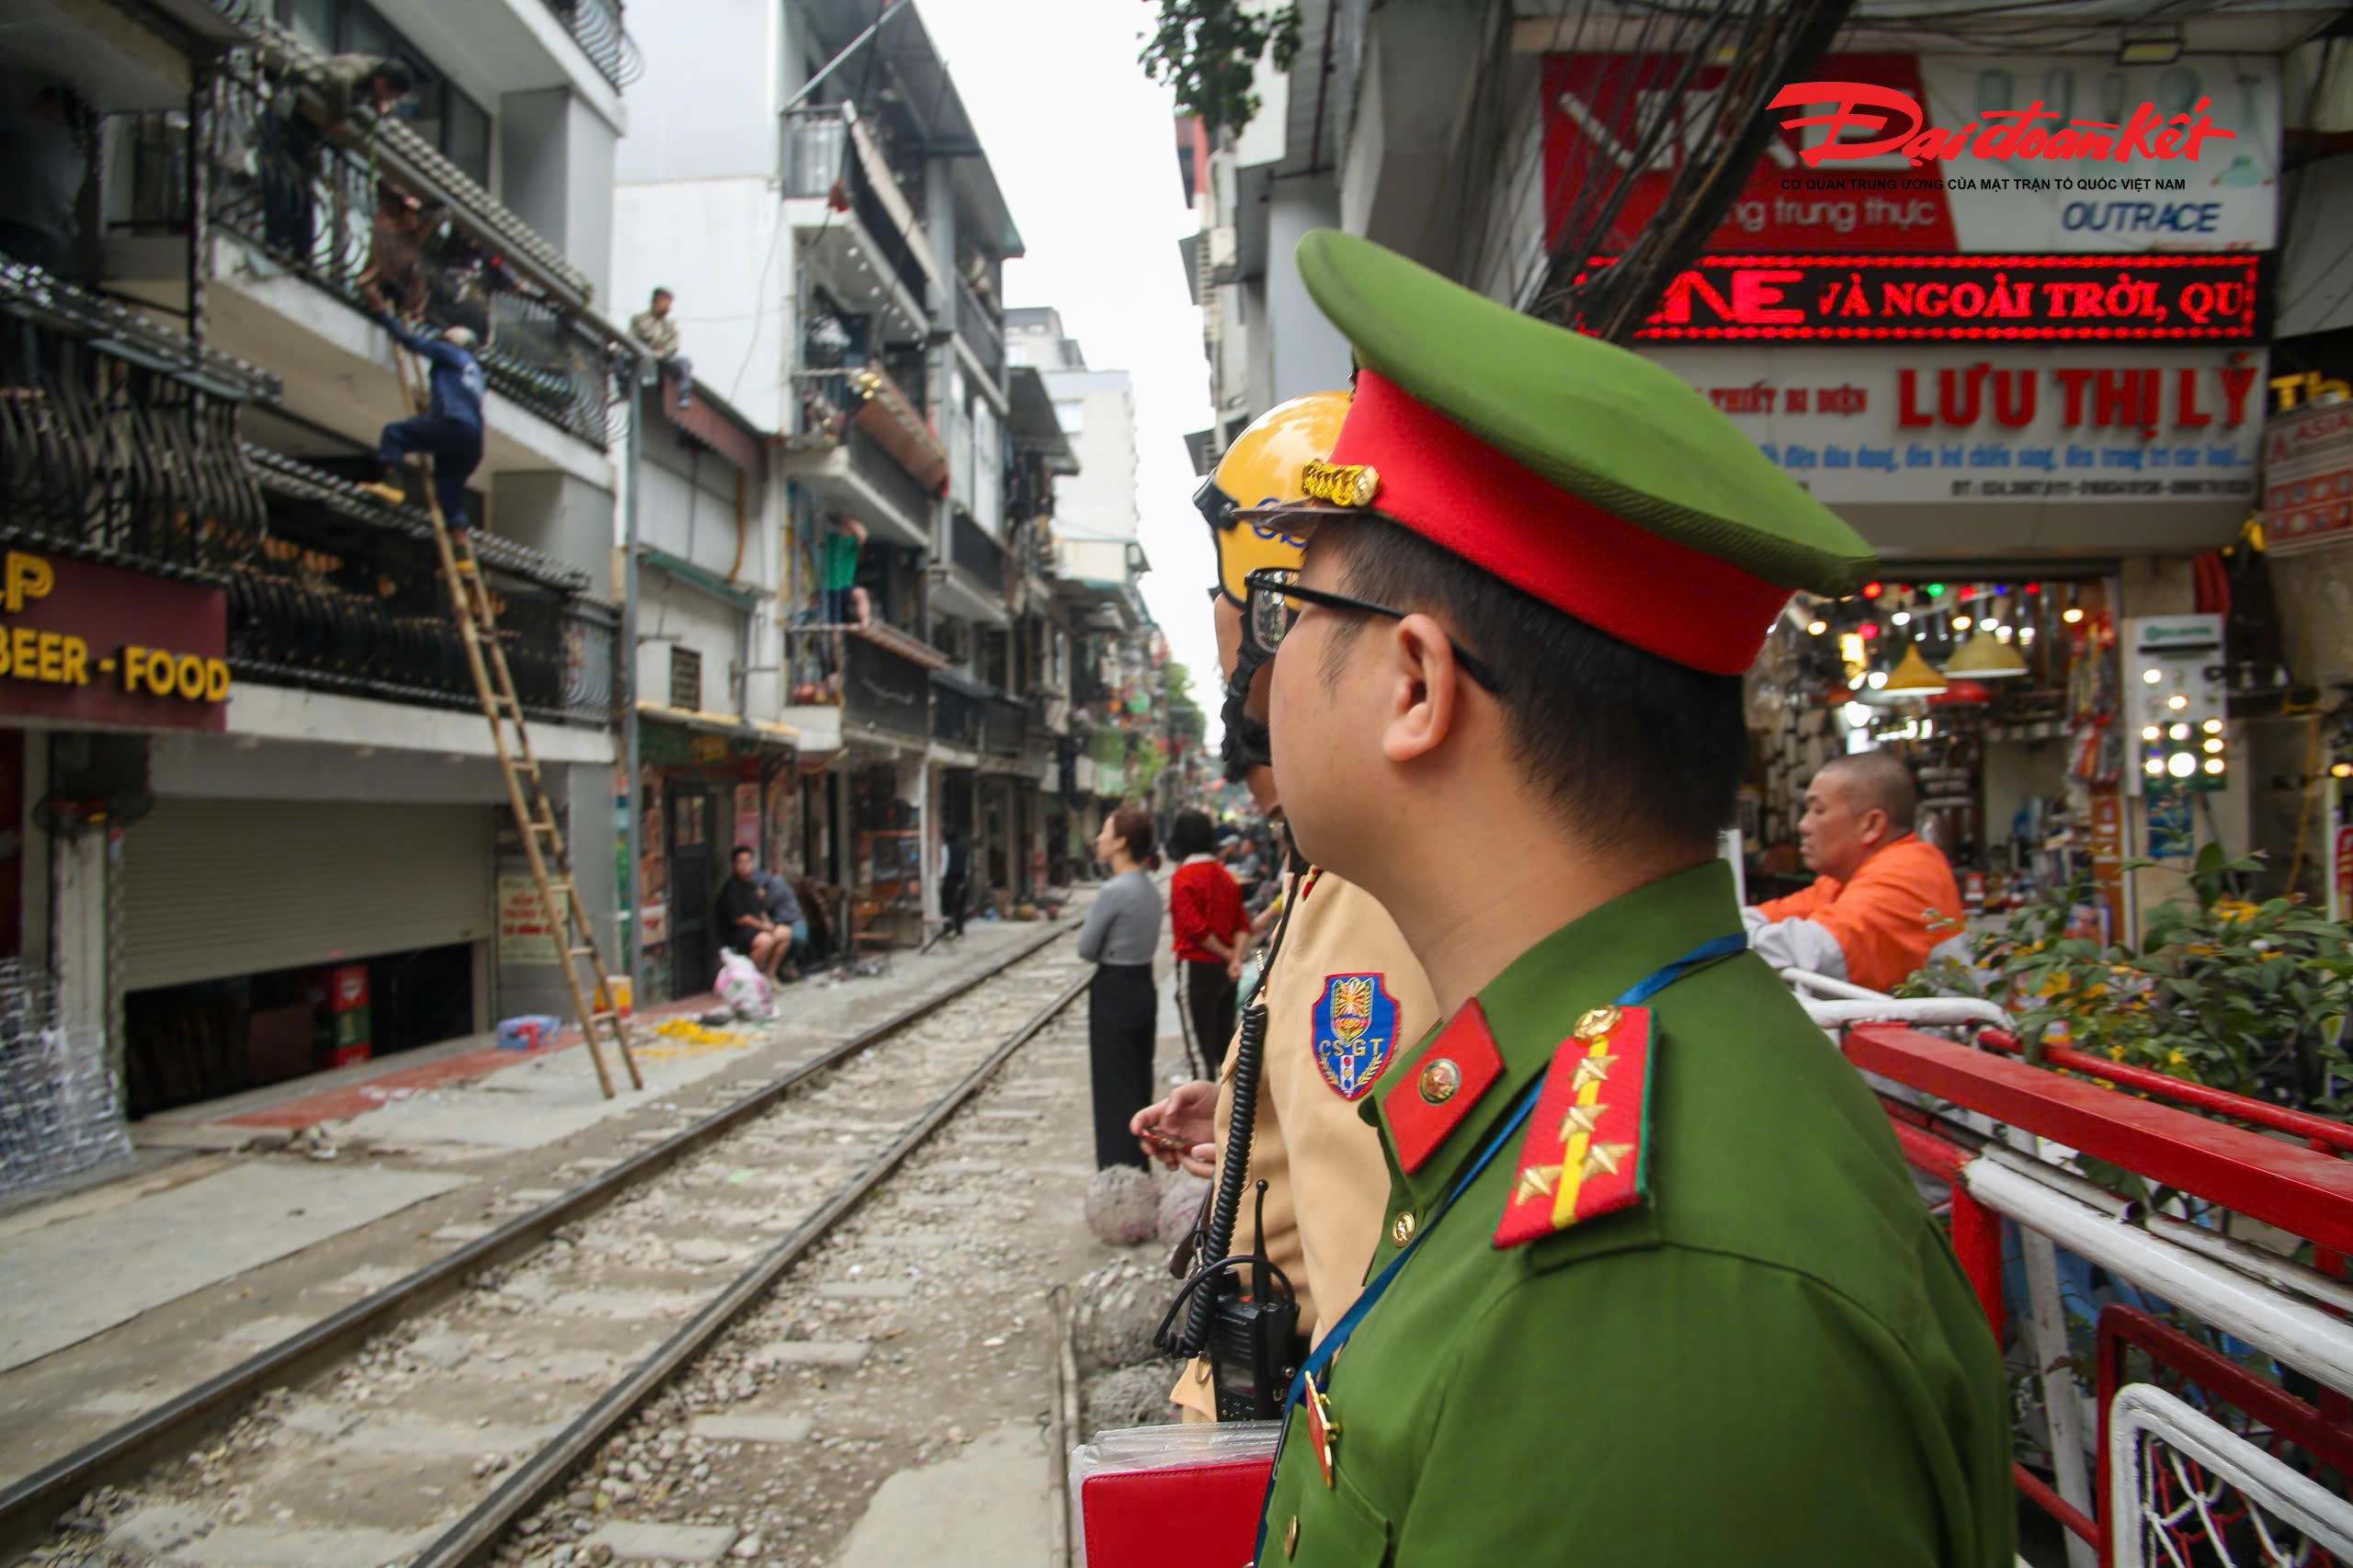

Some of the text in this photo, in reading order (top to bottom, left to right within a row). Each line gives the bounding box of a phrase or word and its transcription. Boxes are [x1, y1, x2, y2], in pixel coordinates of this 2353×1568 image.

[1774, 196, 1857, 233] trung
[2062, 199, 2222, 233] OUTRACE
[1898, 351, 2259, 439] LƯU THỊ LÝ
[124, 645, 231, 702] FOOD
[1318, 1038, 1385, 1058] CSGT
